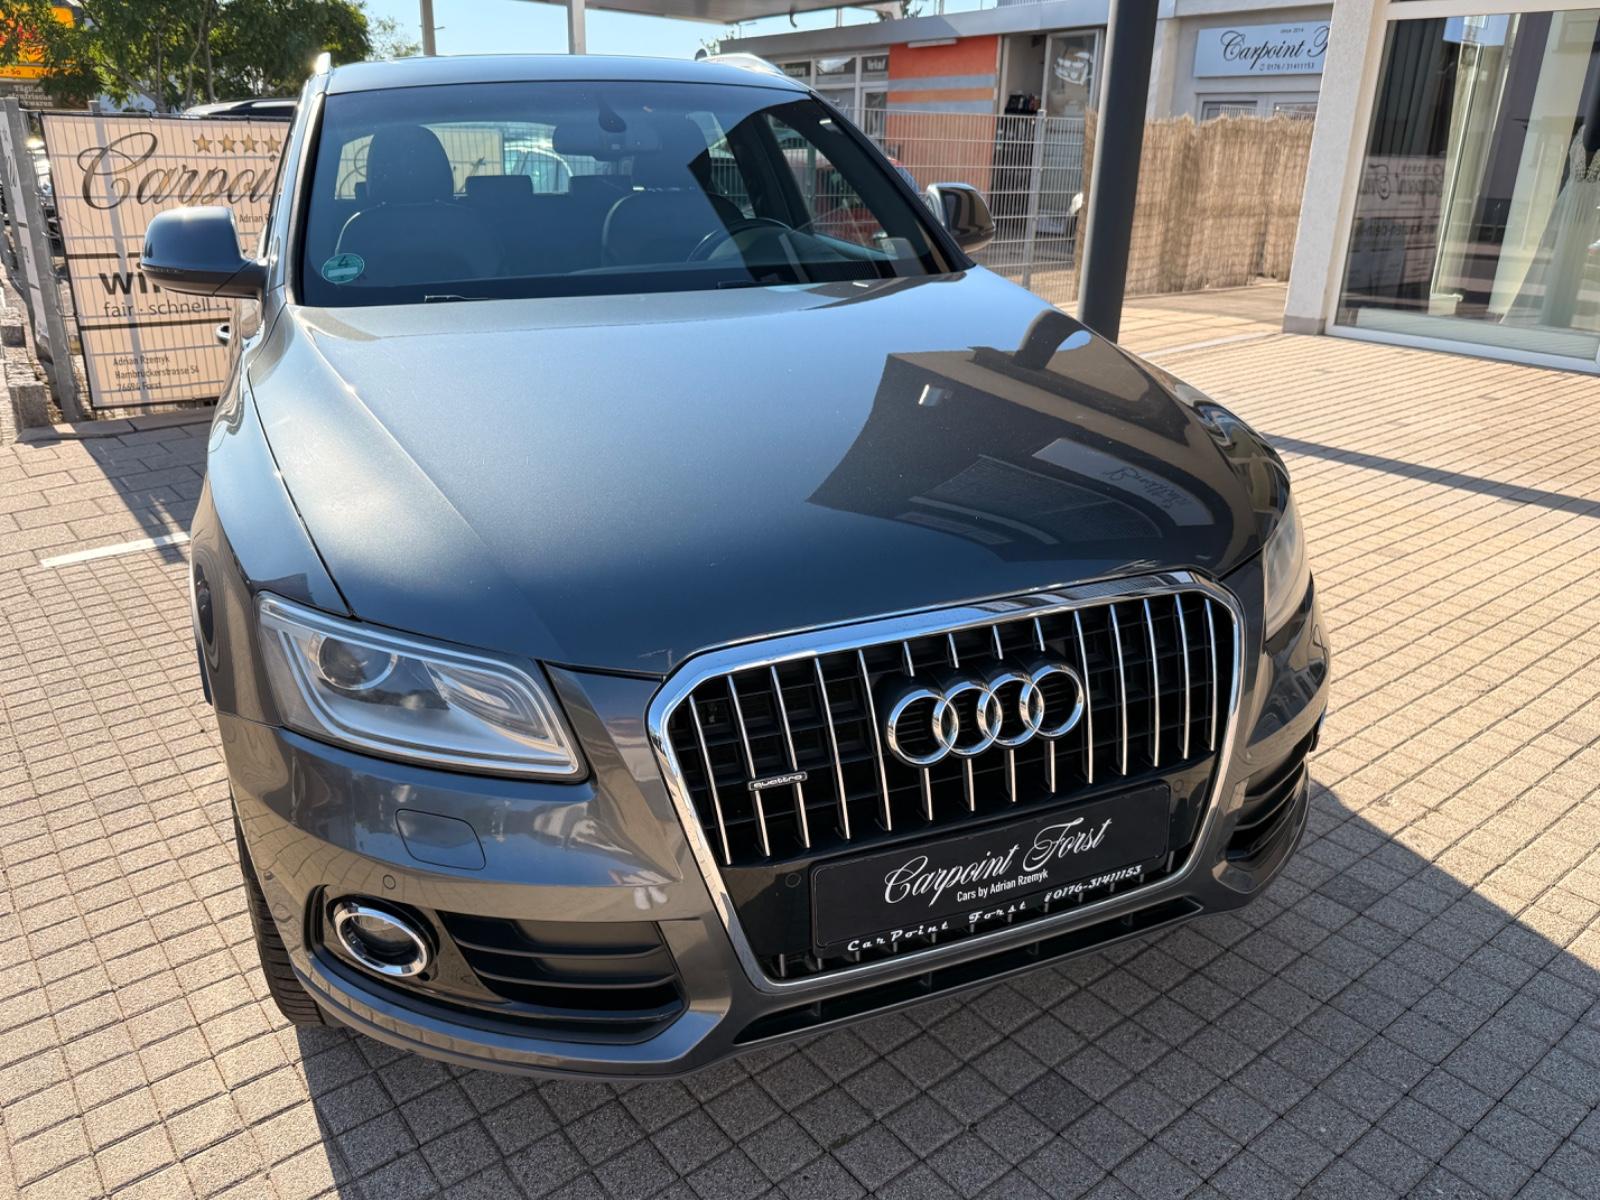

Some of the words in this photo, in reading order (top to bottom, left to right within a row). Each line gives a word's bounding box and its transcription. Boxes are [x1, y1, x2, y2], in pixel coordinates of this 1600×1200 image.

[1221, 30, 1306, 70] Carpoint
[77, 131, 276, 210] Carpoi
[104, 302, 134, 317] fair
[149, 298, 211, 315] schnell
[753, 775, 802, 789] quattro
[885, 844, 1020, 908] Carpoint
[1023, 817, 1113, 872] Forst
[957, 890, 976, 902] Cars
[978, 886, 989, 898] by
[990, 880, 1016, 894] Adrian
[1017, 869, 1049, 886] Rzemyk
